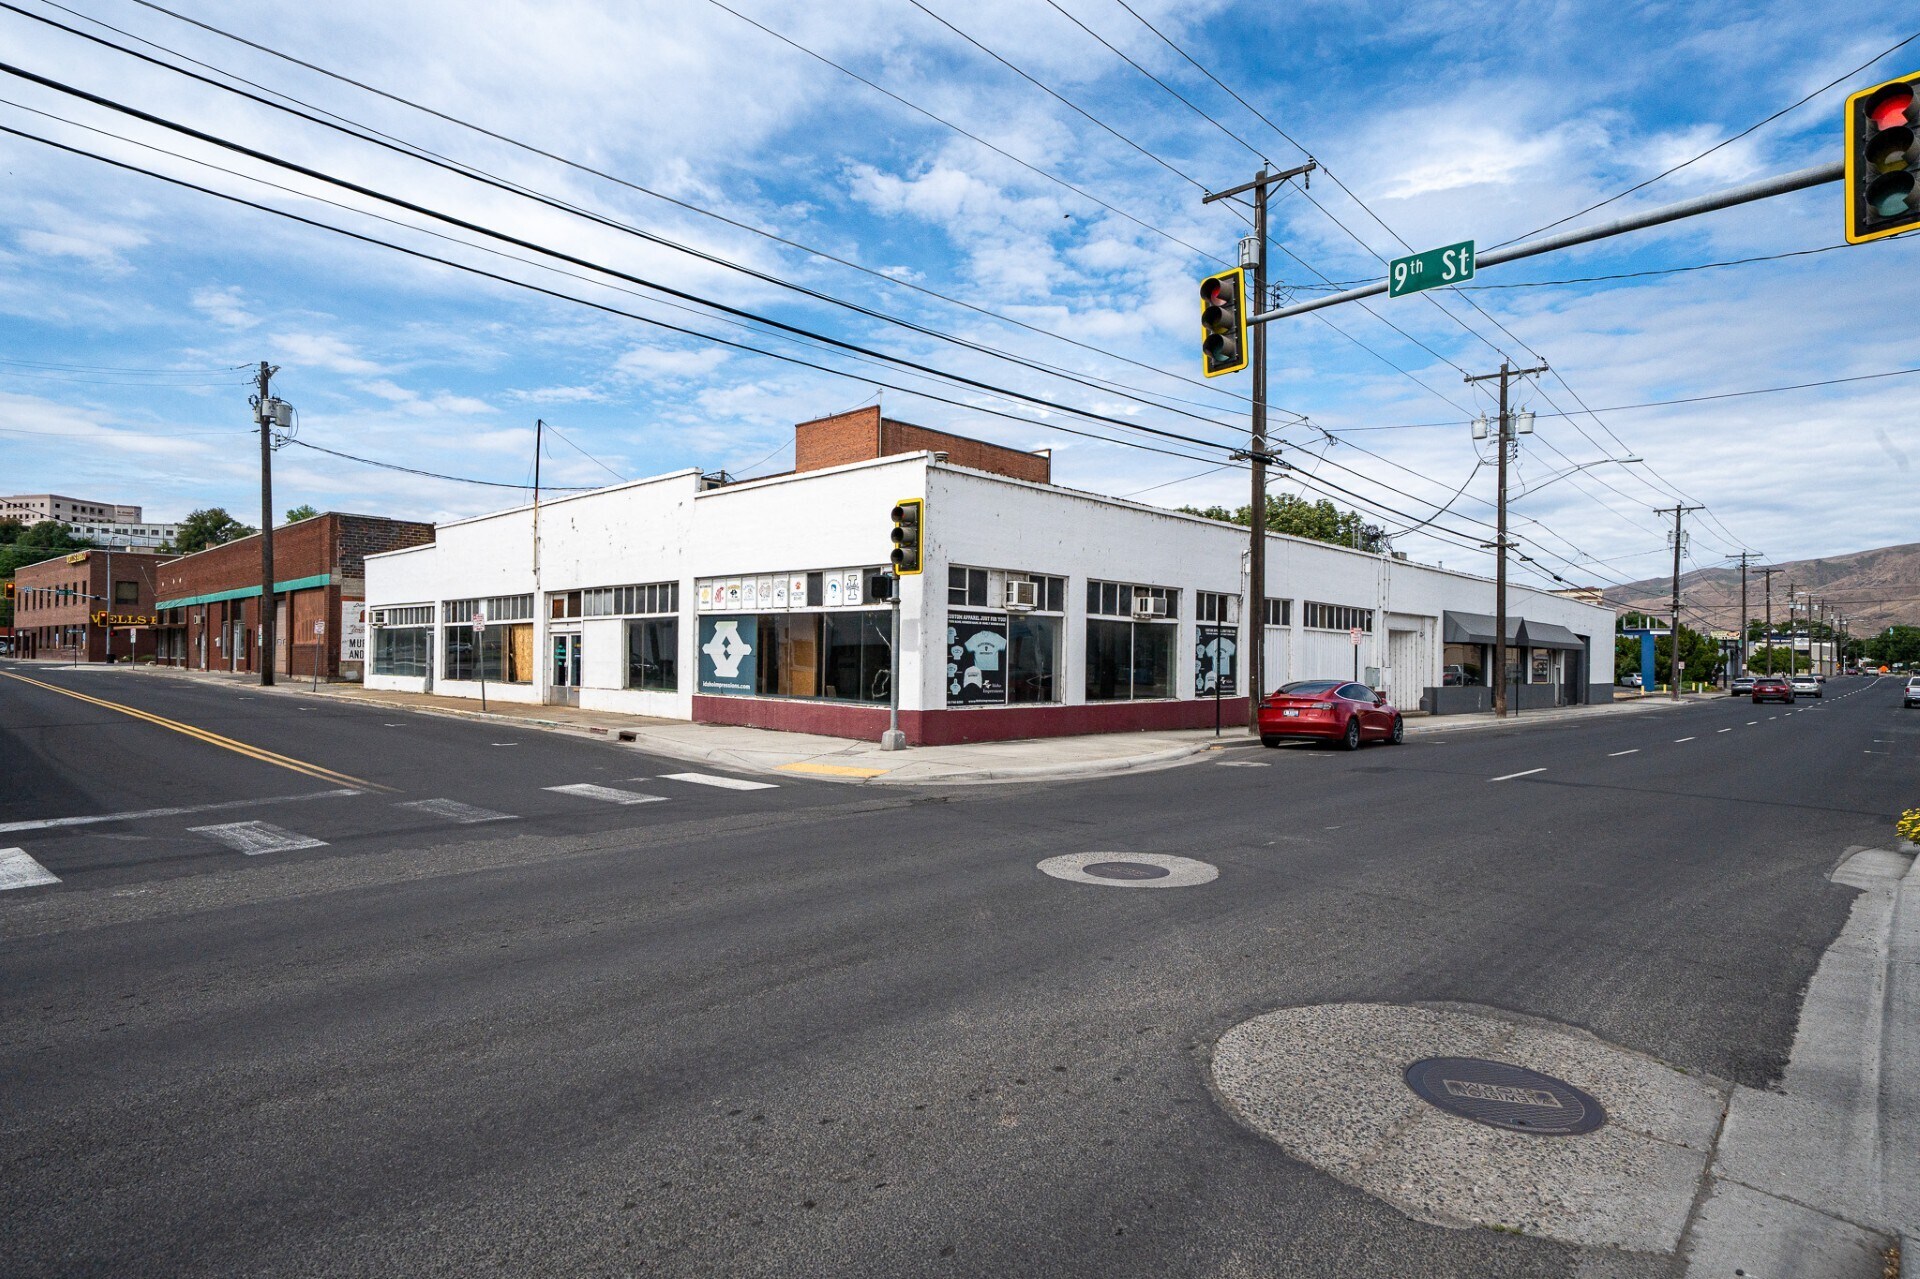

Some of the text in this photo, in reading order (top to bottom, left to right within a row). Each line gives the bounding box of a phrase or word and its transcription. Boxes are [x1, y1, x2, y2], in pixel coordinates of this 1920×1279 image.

[1394, 246, 1469, 292] 9th St
[1456, 1088, 1539, 1105] LEWISTON
[1461, 1081, 1535, 1097] STORM
